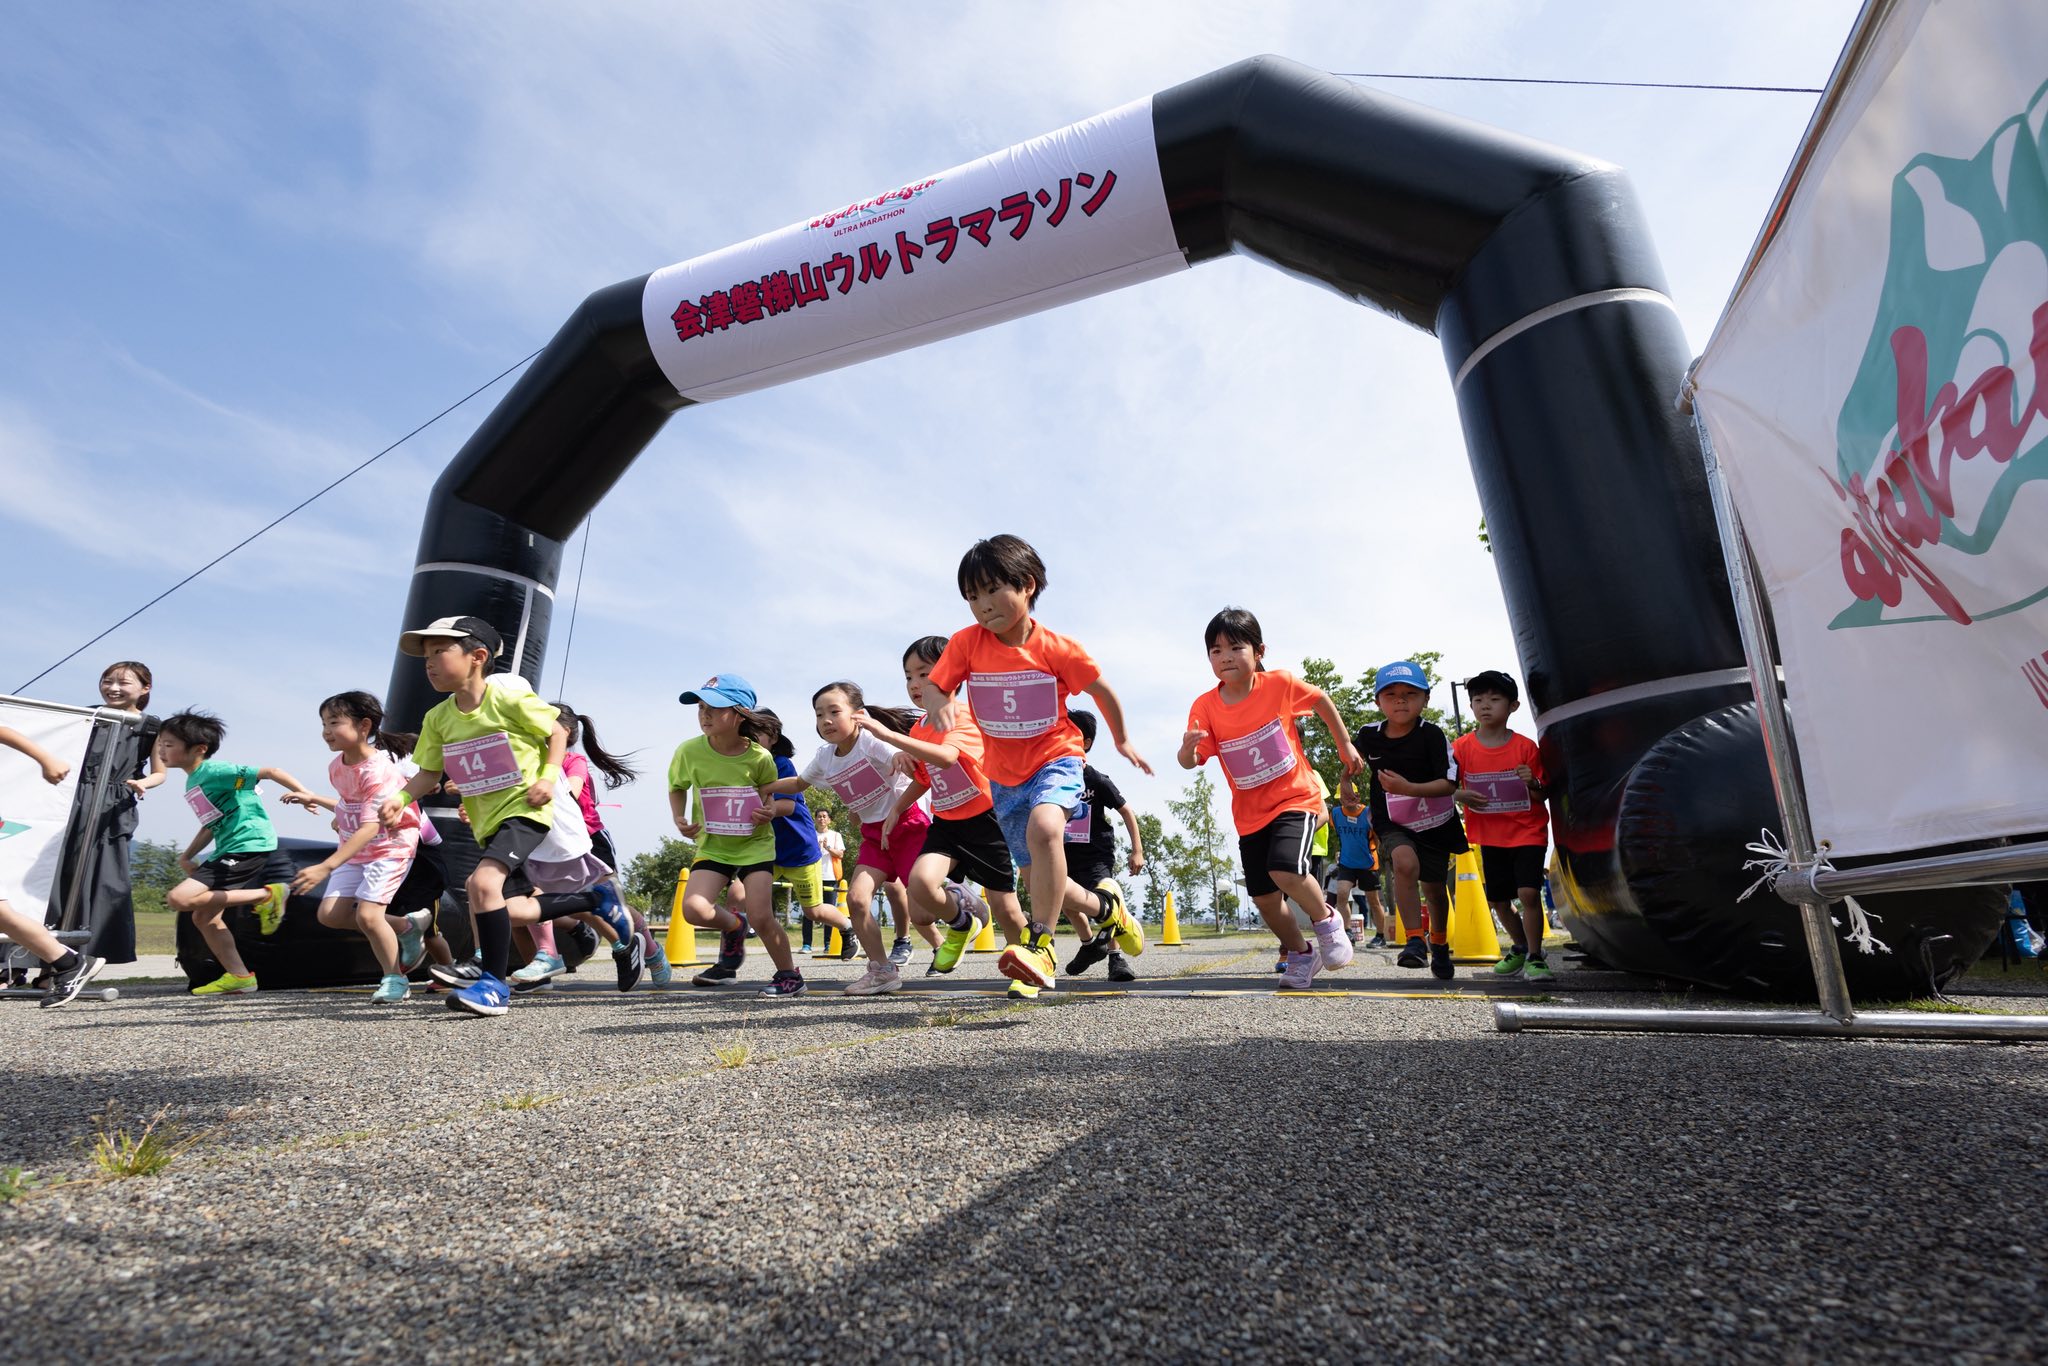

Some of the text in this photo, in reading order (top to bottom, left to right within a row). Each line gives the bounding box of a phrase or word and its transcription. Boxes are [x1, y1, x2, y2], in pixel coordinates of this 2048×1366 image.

[833, 207, 905, 237] ULTRA MARATHON
[671, 169, 1118, 343] 会津磐梯山ウルトラマラソン
[1003, 689, 1017, 713] 5
[459, 752, 487, 775] 14
[1248, 747, 1265, 767] 2
[841, 780, 855, 795] 7
[1488, 782, 1497, 798] 1
[725, 798, 745, 817] 17
[1417, 798, 1428, 812] 4
[343, 813, 358, 829] 11
